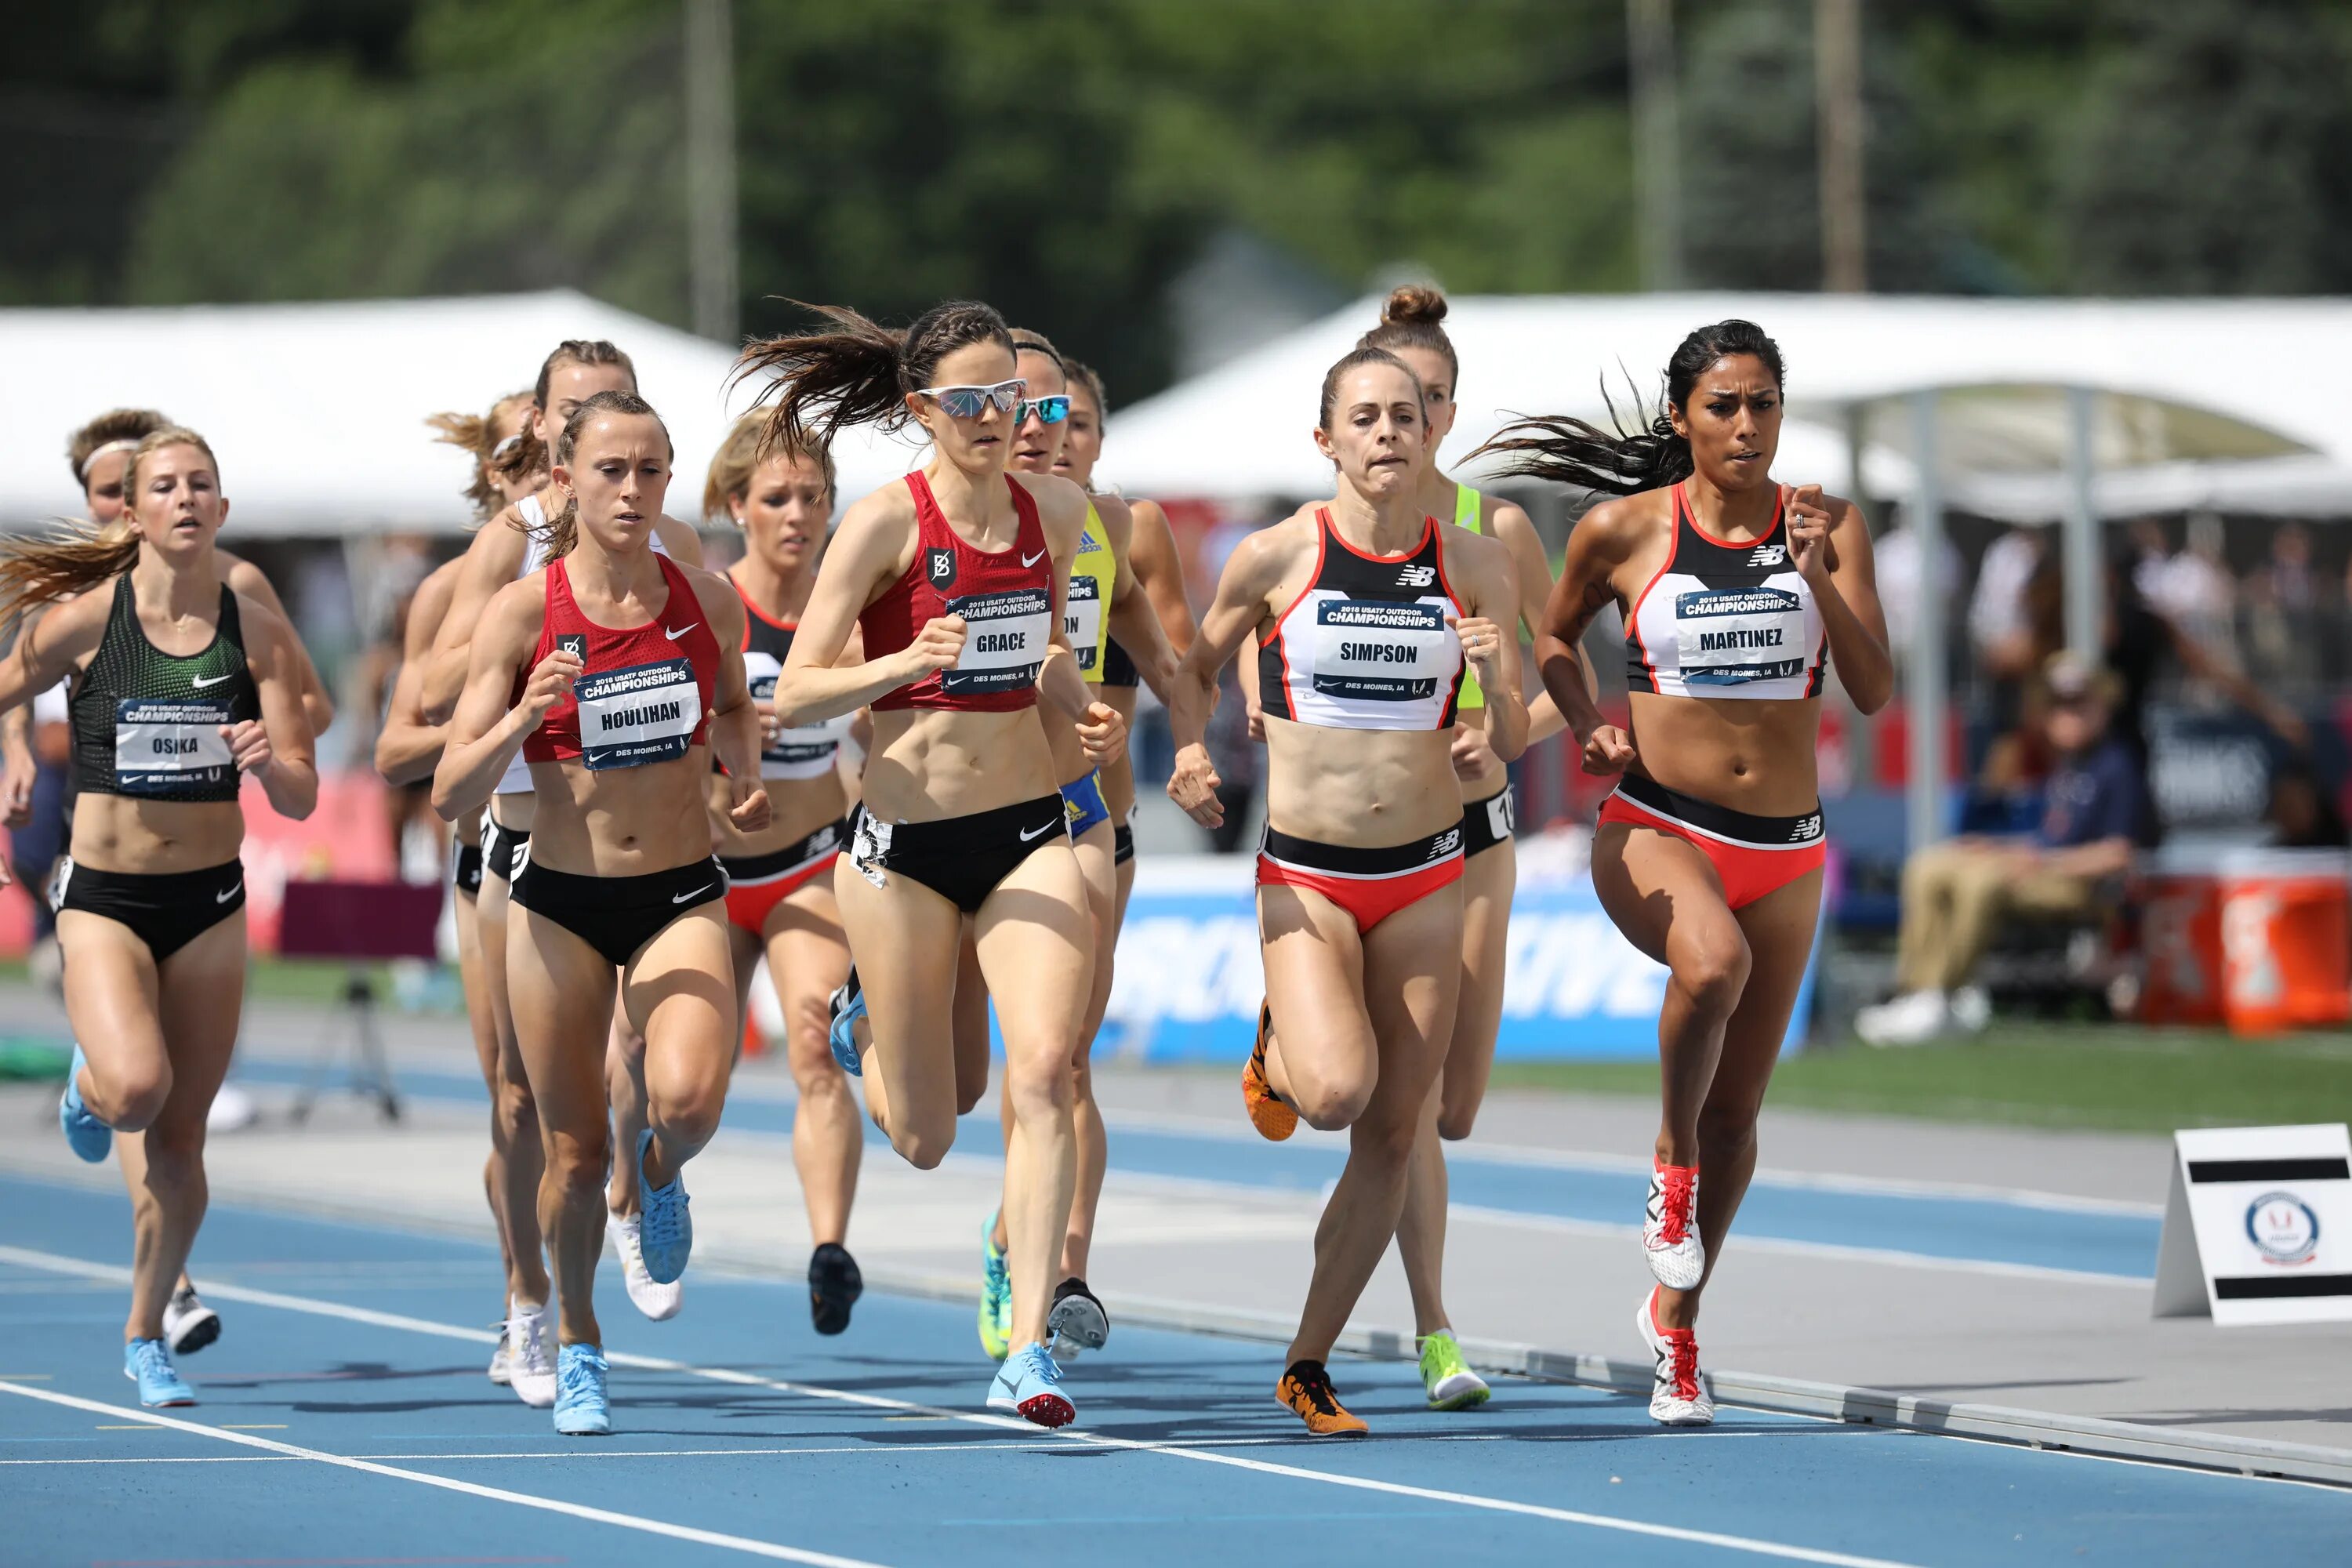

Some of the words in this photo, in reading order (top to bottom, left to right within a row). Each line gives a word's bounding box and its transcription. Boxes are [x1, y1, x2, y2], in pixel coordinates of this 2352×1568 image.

[986, 598, 1006, 607] USATF
[1007, 594, 1036, 604] OUTDOOR
[1719, 594, 1743, 603] USATF
[956, 600, 1046, 619] CHAMPIONSHIPS
[1327, 612, 1436, 627] CHAMPIONSHIPS
[977, 632, 1025, 653] GRACE
[1700, 628, 1784, 651] MARTINEZ
[1341, 642, 1417, 663] SIMPSON
[595, 677, 613, 686] 2018
[615, 672, 637, 682] USATF
[638, 666, 672, 677] OUTDOOR
[989, 673, 1018, 682] MOINES,
[584, 670, 687, 699] CHAMPIONSHIPS
[1363, 683, 1395, 691] MOINES,
[125, 711, 229, 722] CHAMPIONSHIPS
[601, 701, 681, 731] HOULIHAN
[153, 738, 198, 754] OSIKA
[633, 746, 663, 755] MOINES,
